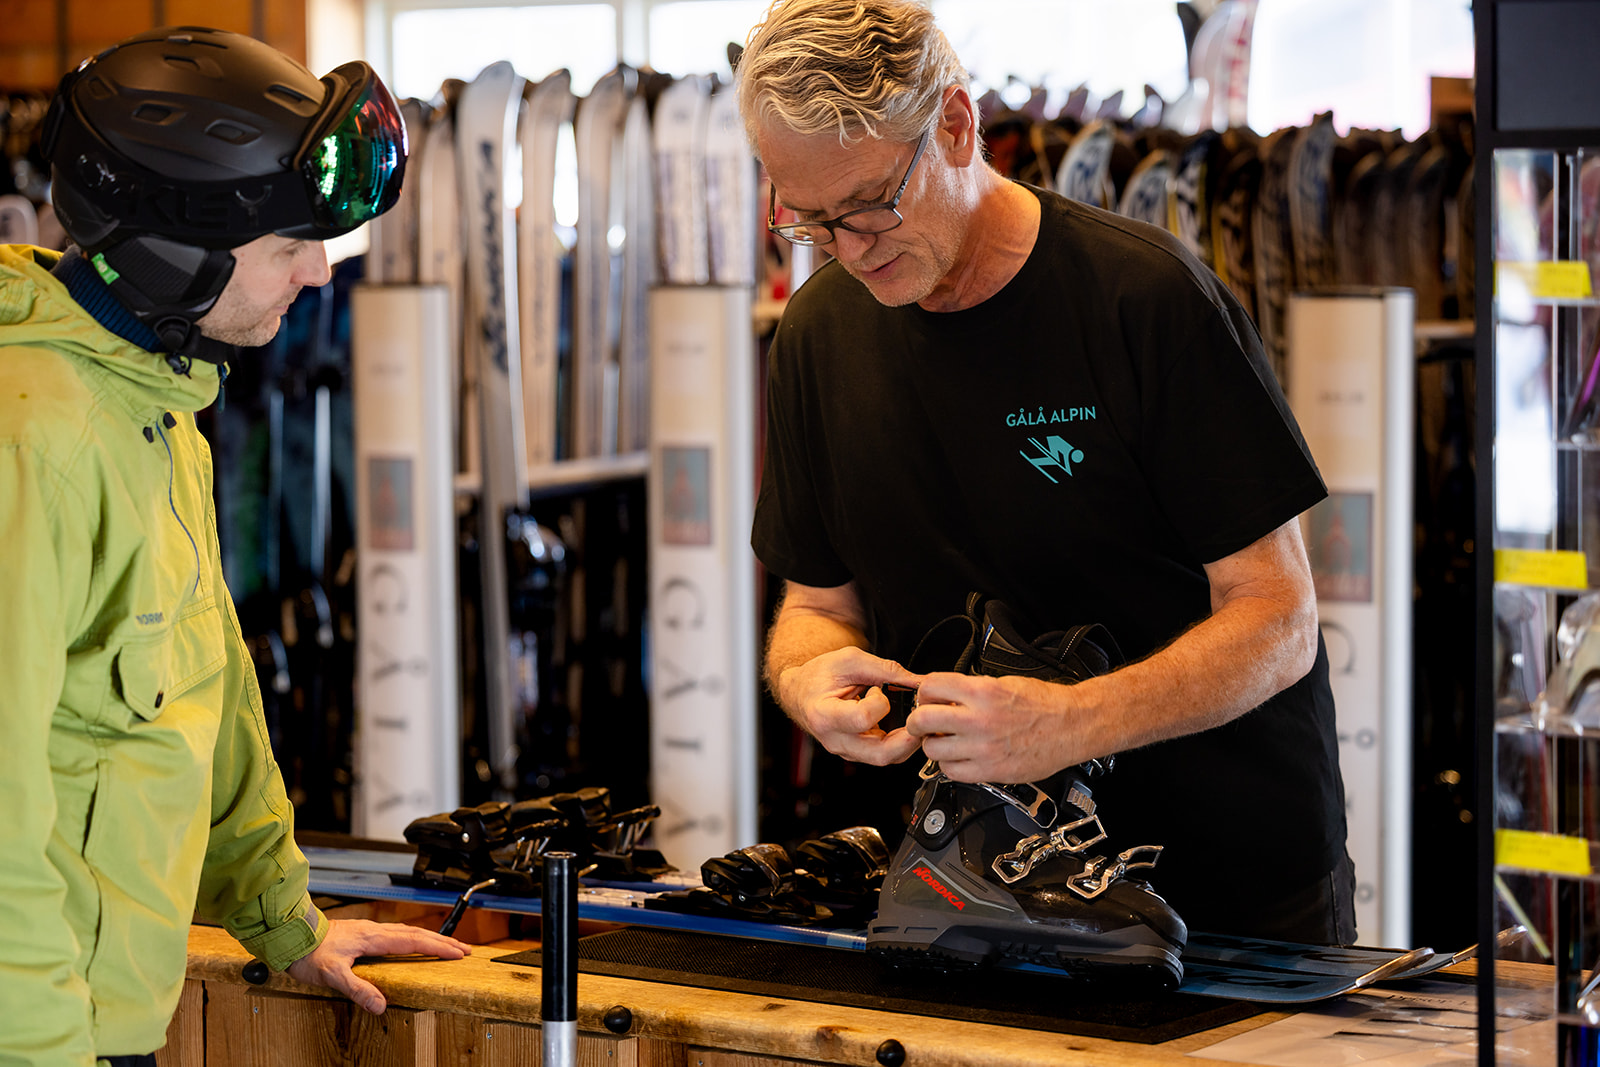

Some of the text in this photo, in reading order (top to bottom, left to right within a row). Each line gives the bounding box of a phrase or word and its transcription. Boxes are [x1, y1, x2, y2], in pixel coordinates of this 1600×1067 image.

[1006, 406, 1096, 427] GÅLÅ ALPIN
[912, 866, 966, 911] NORDICA
